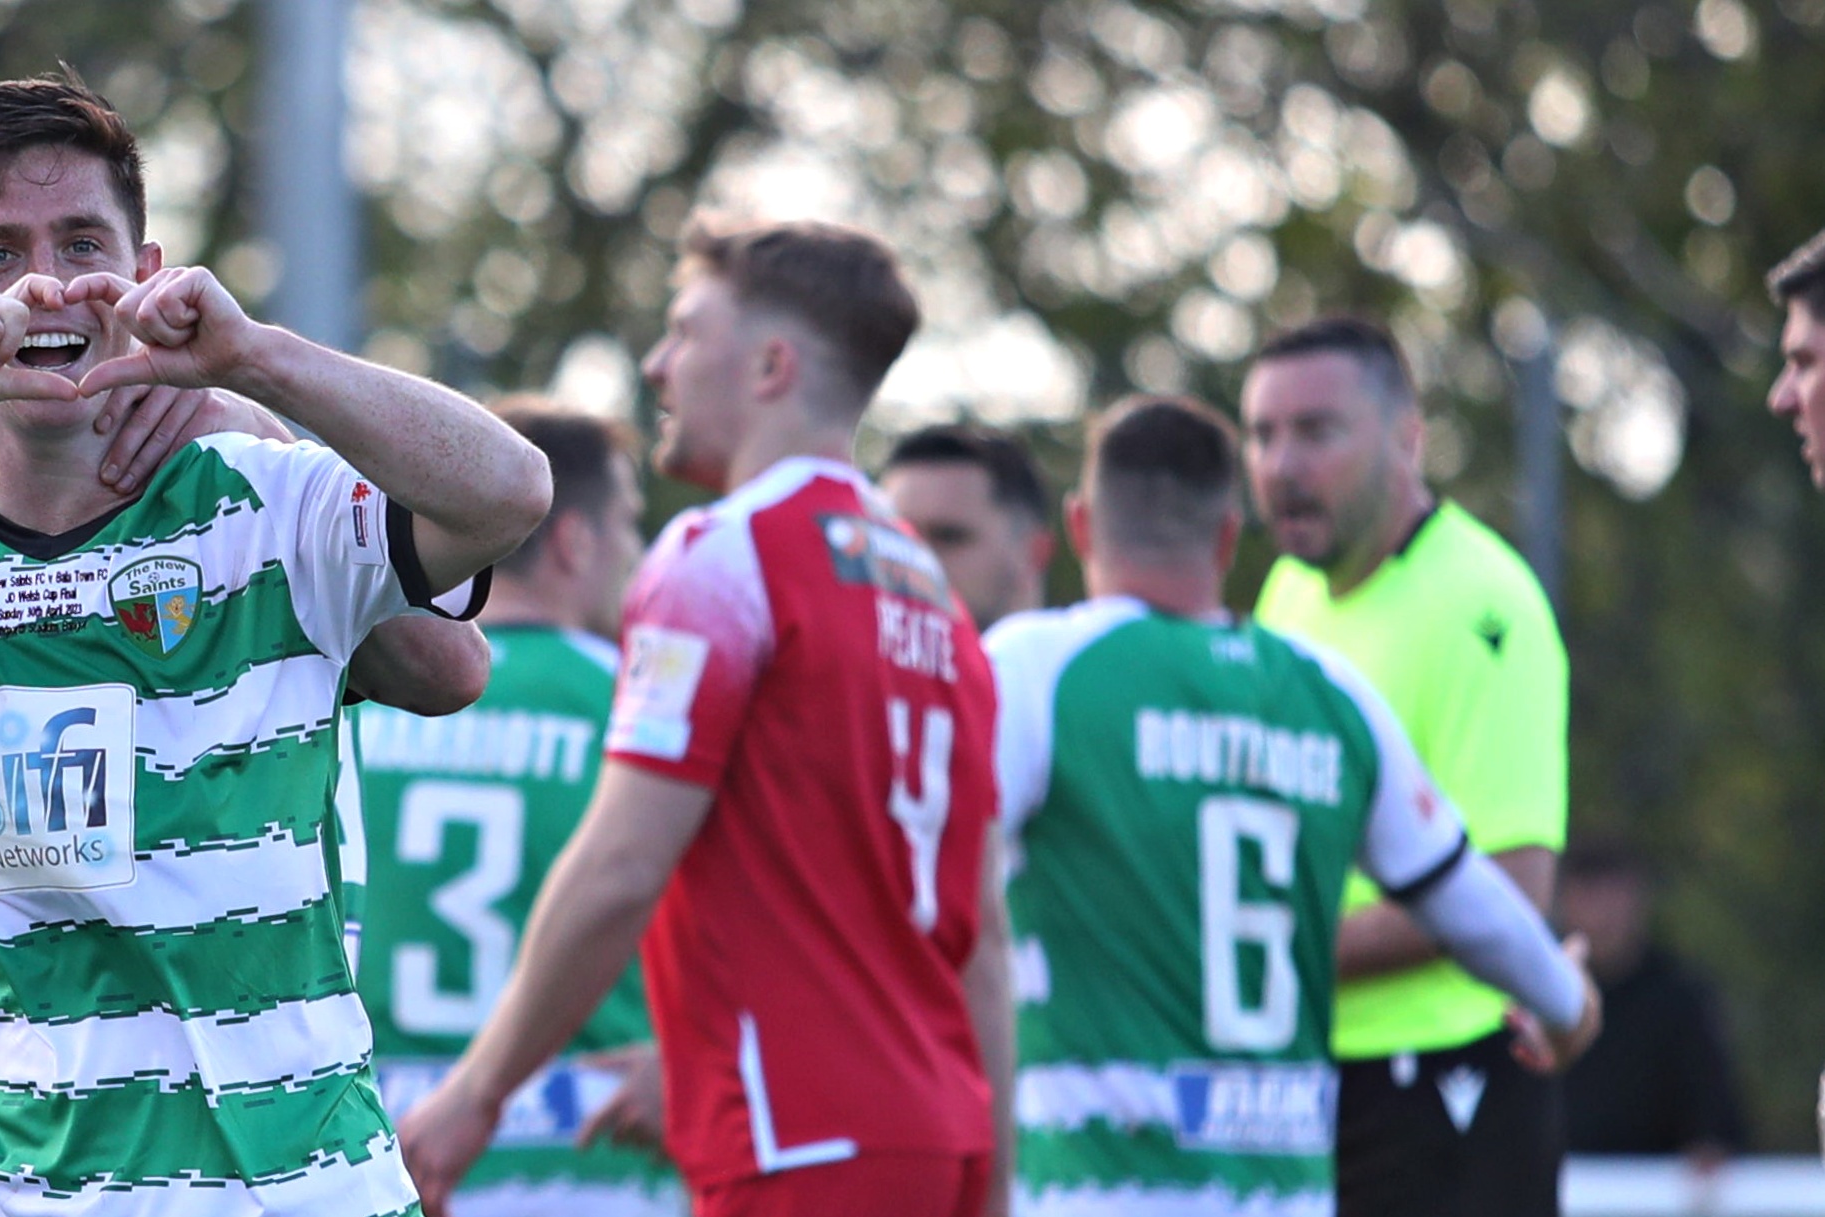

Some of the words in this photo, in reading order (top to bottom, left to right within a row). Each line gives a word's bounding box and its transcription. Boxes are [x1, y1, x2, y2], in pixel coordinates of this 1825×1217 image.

[35, 572, 45, 586] FC
[97, 567, 108, 581] FC
[125, 565, 150, 581] The
[155, 560, 186, 572] New
[129, 577, 187, 596] Saints
[885, 698, 954, 936] 4
[391, 780, 524, 1035] 3
[1200, 796, 1301, 1053] 6
